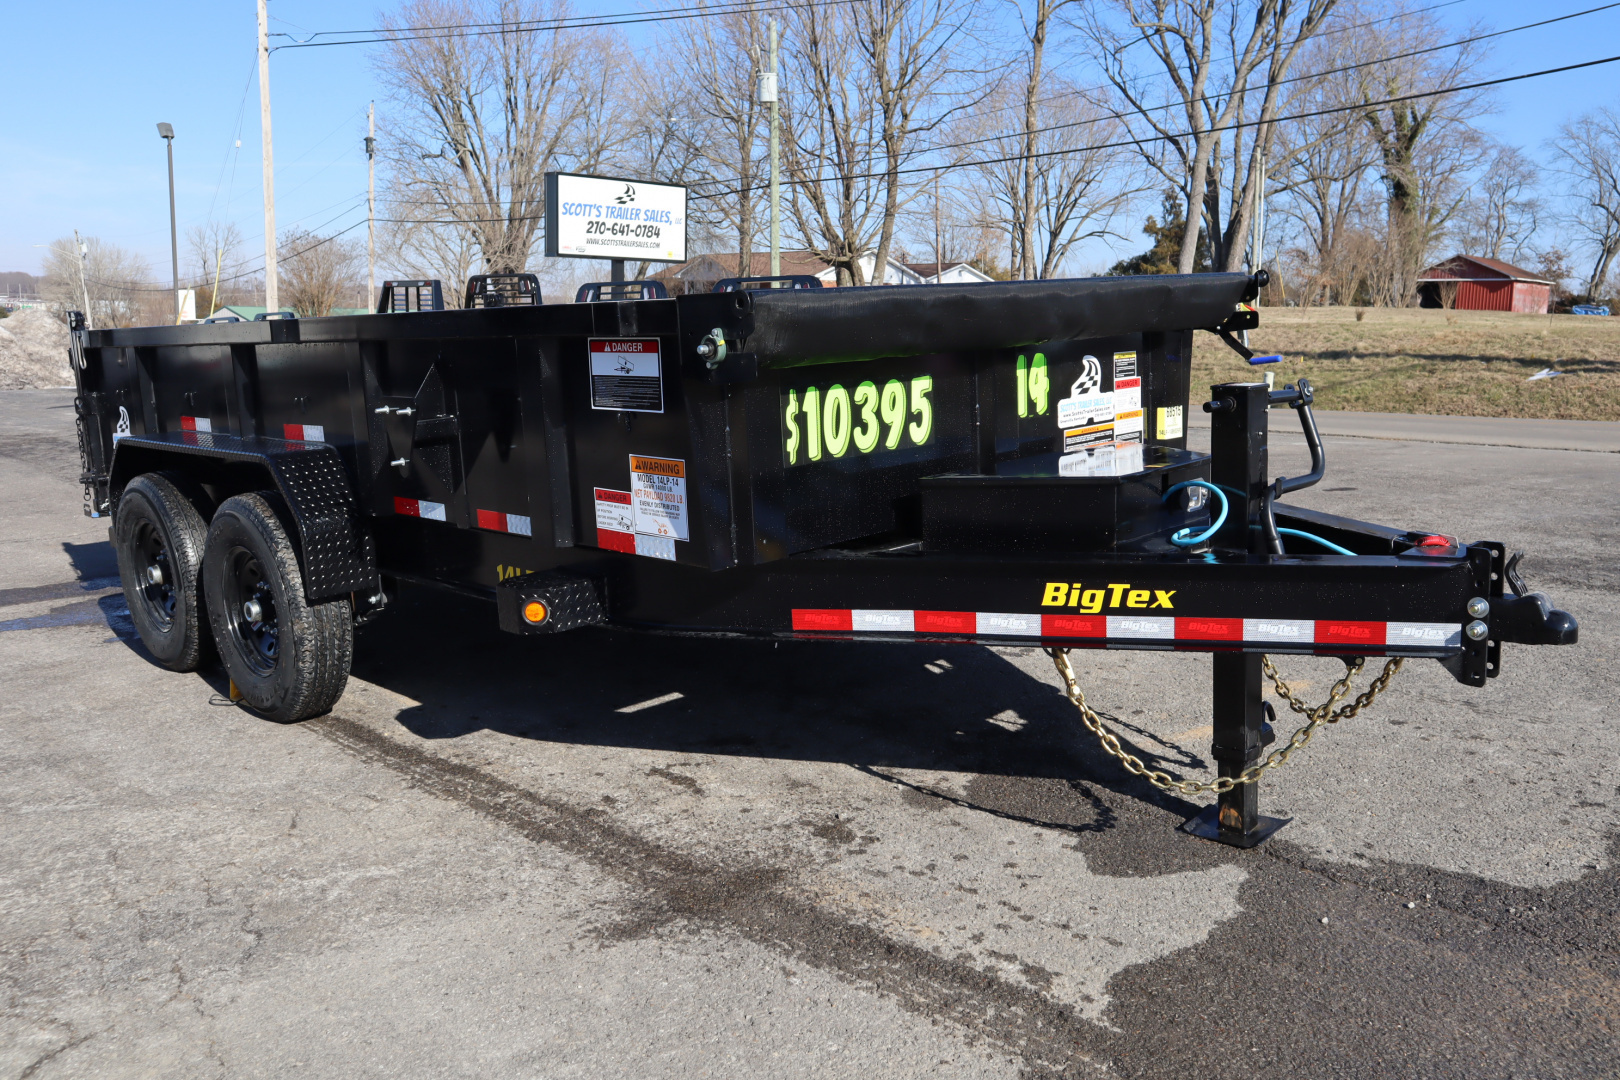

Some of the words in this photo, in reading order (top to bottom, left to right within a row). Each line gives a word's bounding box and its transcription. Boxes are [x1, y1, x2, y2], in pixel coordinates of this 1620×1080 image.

[562, 202, 602, 218] SCOTT'S
[605, 206, 641, 221] TRAILER
[644, 209, 672, 226] SALES,
[586, 221, 661, 238] 270-641-0784
[586, 238, 660, 249] WWW.SCOTTSTRAILERSALES.COM
[612, 342, 643, 352] DANGER
[1016, 353, 1049, 418] 14
[1121, 380, 1138, 388] DANGER
[786, 375, 932, 465] $10395
[641, 460, 680, 475] WARNING
[638, 474, 655, 484] MODEL
[657, 476, 679, 486] 14LP-14
[604, 492, 627, 502] DANGER
[634, 488, 642, 498] NET
[644, 490, 663, 501] PAYLOAD
[654, 502, 680, 511] DISTRIBUTED
[1041, 582, 1177, 614] BigTex
[865, 614, 901, 624] BigTex
[990, 617, 1027, 627] BigTex
[1121, 621, 1159, 630] BigTex
[1258, 624, 1299, 634] BigTex
[1402, 627, 1445, 637] BigTex
